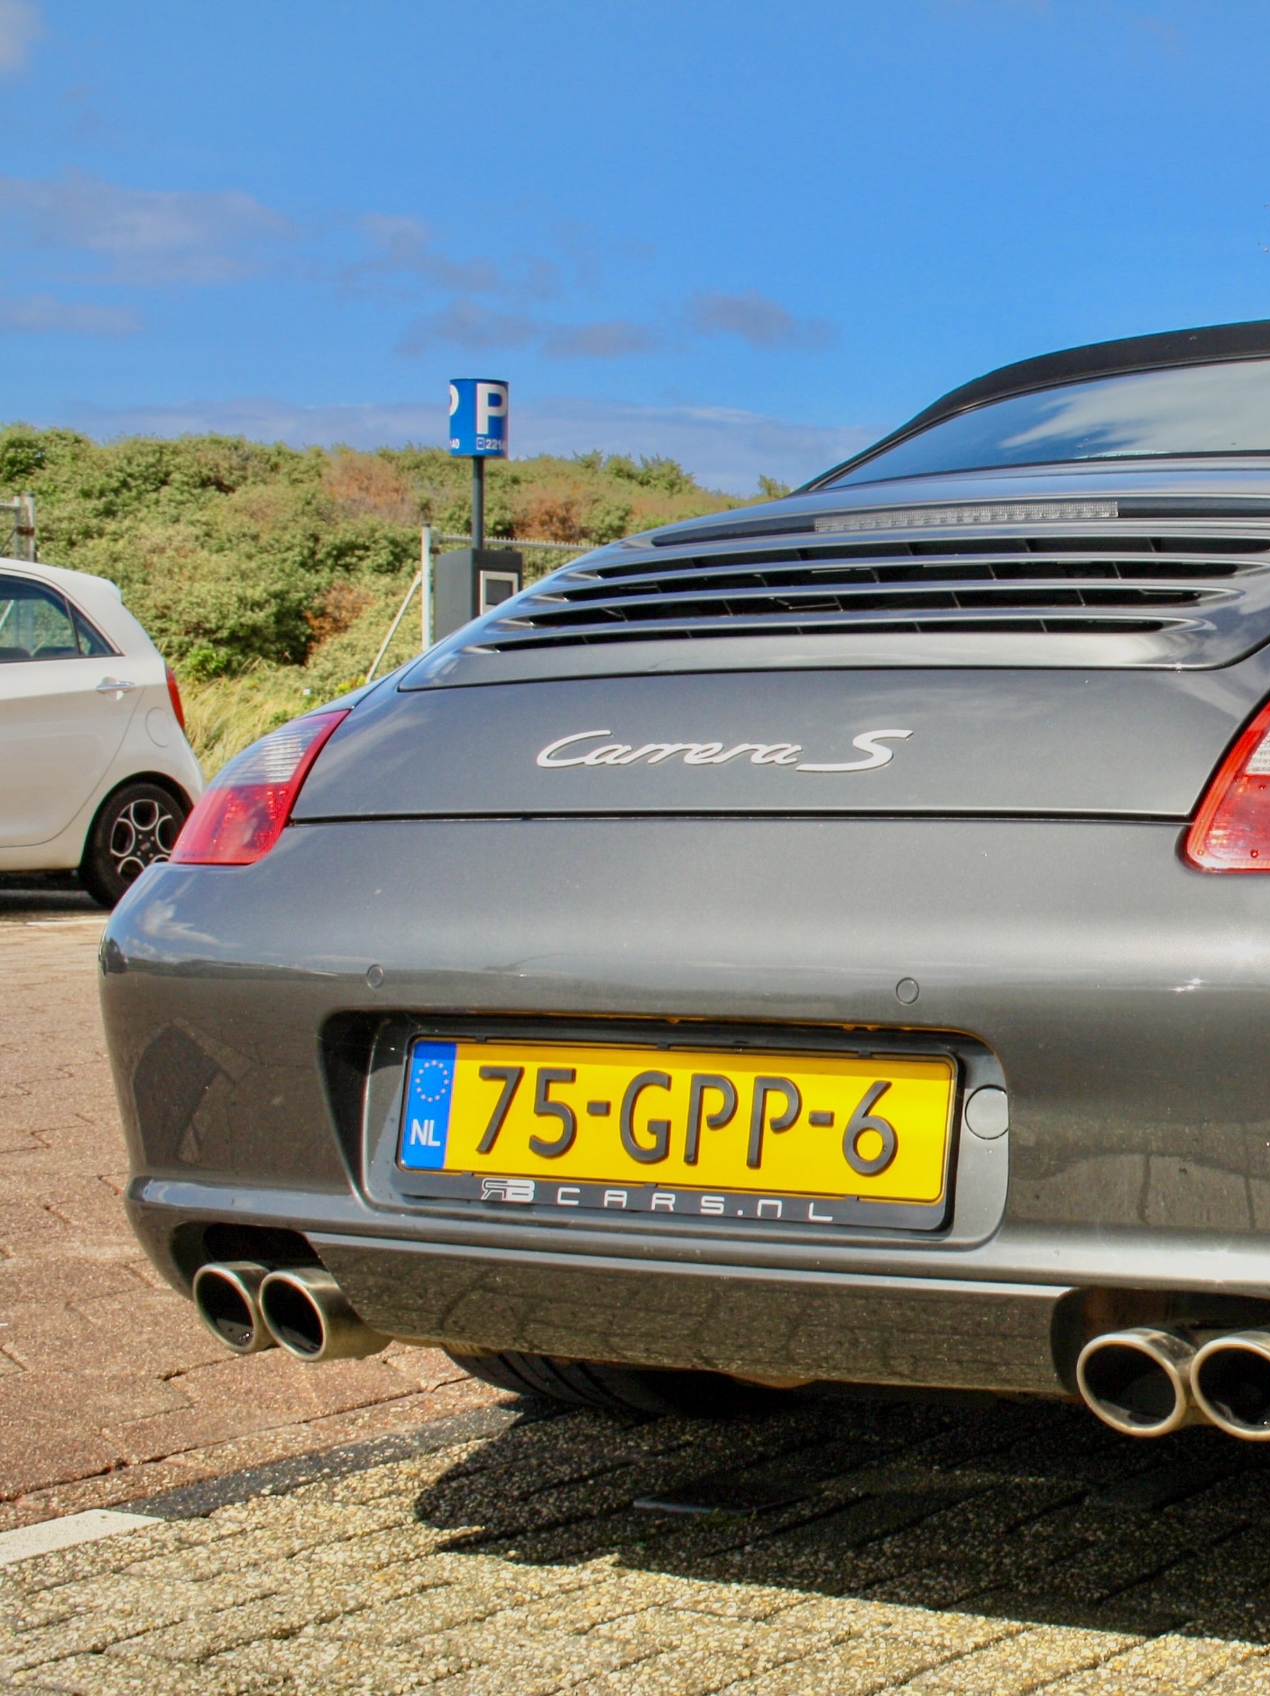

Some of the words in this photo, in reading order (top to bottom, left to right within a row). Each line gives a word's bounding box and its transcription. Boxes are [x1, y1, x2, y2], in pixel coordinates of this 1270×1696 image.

[476, 383, 508, 435] P
[537, 730, 803, 768] Carrera
[796, 729, 914, 773] S
[409, 1118, 442, 1147] NL
[475, 1065, 898, 1177] 75-GPP-6
